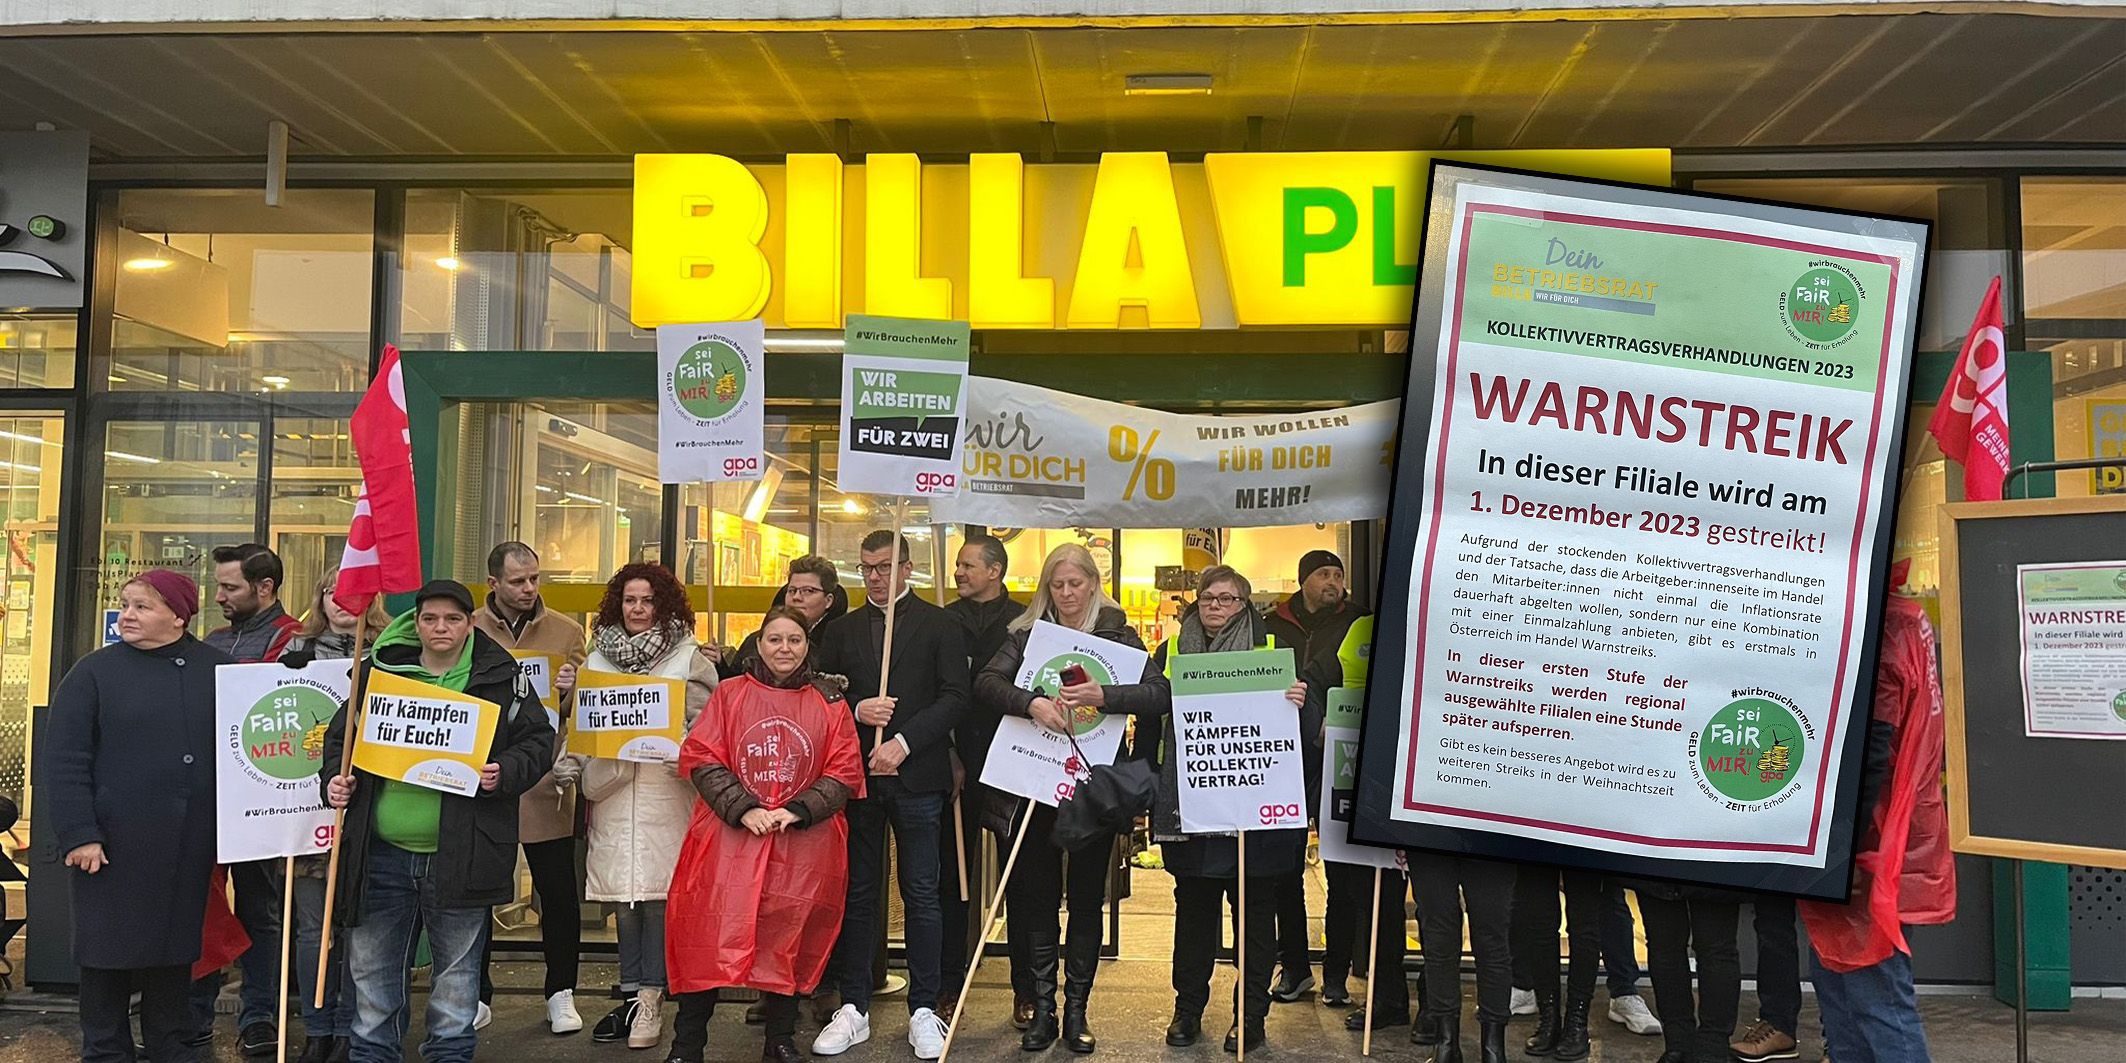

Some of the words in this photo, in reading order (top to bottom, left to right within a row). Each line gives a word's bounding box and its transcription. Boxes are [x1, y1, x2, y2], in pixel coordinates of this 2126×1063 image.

[631, 151, 1201, 329] BILLA
[1282, 186, 1418, 288] PL
[1546, 237, 1604, 270] Dein
[1492, 263, 1658, 300] BETRIEBSRAT
[1813, 276, 1830, 287] sei
[1536, 292, 1548, 301] WIR
[1549, 292, 1563, 303] FÜR
[1563, 295, 1580, 305] DICH
[856, 331, 959, 346] #WirBrauchenMehr
[1486, 319, 1811, 374] KOLLEKTIVVERTRAGSVERHANDLUNGEN
[1813, 360, 1855, 379] 2023
[695, 347, 712, 360] sei
[860, 371, 897, 388] WIR
[858, 390, 951, 411] ARBEITEN
[1196, 425, 1246, 440] WIR
[1253, 415, 1349, 436] WOLLEN
[1469, 371, 1854, 465] WARNSTREIK
[675, 439, 744, 448] #WirBrauchenMehr
[858, 426, 896, 446] FÜR
[900, 431, 949, 449] ZWEI
[1984, 423, 2010, 460] MEINE
[963, 443, 1002, 477] ÜR
[1009, 453, 1086, 483] DICH
[1108, 424, 1176, 502] %
[1217, 448, 1267, 473] FÜR
[1272, 445, 1332, 471] DICH
[1975, 432, 2010, 475] GEWERK
[723, 457, 757, 477] gpa
[915, 472, 955, 493] gpa
[1478, 448, 1505, 475] In
[1514, 452, 1607, 487] dieser
[1613, 465, 1699, 499] Filiale
[1708, 479, 1774, 508] wird
[1781, 493, 1828, 516] am
[1235, 484, 1311, 510] MEHR!
[1469, 490, 1492, 514] 1.
[1501, 493, 1633, 530] Dezember
[1639, 510, 1701, 538] 2023
[1706, 523, 1827, 555] gestreikt!
[1185, 533, 1202, 547] für
[124, 558, 183, 566] Restaurant
[1460, 533, 1518, 549] Aufgrund
[1528, 540, 1549, 552] der
[1557, 546, 1627, 562] stockenden
[1636, 553, 1825, 588] Kollektivvertragsverhandlungen
[1458, 552, 1482, 564] und
[1485, 554, 1507, 566] der
[1510, 556, 1566, 575] Tatsache,
[1570, 564, 1597, 577] dass
[1600, 567, 1619, 579] die
[1621, 570, 1759, 597] Arbeitgeber:innenseite
[1763, 587, 1778, 599] im
[1781, 590, 1824, 605] Handel
[1455, 569, 1478, 582] den
[1492, 573, 1600, 595] Mitarbeiter:innen
[1613, 588, 1644, 601] nicht
[1656, 593, 1697, 607] einmal
[1710, 599, 1728, 611] die
[1742, 603, 1822, 624] Inflationsrate
[1453, 587, 1514, 605] dauerhaft
[1520, 595, 1572, 611] abgelten
[1579, 603, 1622, 619] wollen,
[1629, 610, 1678, 623] sondern
[1684, 617, 1705, 626] nur
[1711, 618, 1737, 631] eine
[1743, 622, 1819, 642] Kombination
[2029, 610, 2126, 625] WARNSTRE
[1449, 621, 1513, 641] Österreich
[1516, 631, 1531, 643] im
[1535, 633, 1578, 648] Handel
[1582, 638, 1656, 658] Warnstreiks.
[1451, 606, 1472, 618] mit
[1482, 609, 1514, 622] einer
[1524, 613, 1612, 636] Einmalzahlung
[1621, 626, 1678, 643] anbieten,
[1688, 633, 1712, 646] gibt
[1722, 639, 1735, 649] es
[1745, 642, 1796, 657] erstmals
[1806, 647, 1817, 659] in
[2045, 631, 2072, 639] dieser
[2074, 630, 2100, 639] Filiale
[2102, 630, 2124, 639] wird
[2043, 642, 2083, 650] Dezember
[1182, 667, 1283, 680] #WirBrauchenMehr
[1448, 649, 1461, 662] In
[1479, 653, 1525, 670] dieser
[1542, 663, 1588, 678] ersten
[1606, 668, 1645, 685] Stufe
[1663, 675, 1688, 689] der
[273, 693, 298, 710] sei
[578, 690, 597, 707] Wir
[600, 687, 660, 708] kämpfen
[1446, 669, 1533, 693] Warnstreiks
[1551, 686, 1607, 702] werden
[1625, 695, 1685, 711] regional
[370, 695, 394, 716] Wir
[396, 699, 469, 725] kämpfen
[588, 711, 608, 729] für
[611, 709, 648, 728] Euch!
[1182, 711, 1213, 725] WIR
[1444, 693, 1536, 714] ausgewählte
[1540, 703, 1591, 721] Filialen
[1596, 711, 1627, 726] eine
[1630, 715, 1682, 732] Stunde
[1731, 686, 1816, 741] #wirbrauchenmehr
[1736, 706, 1760, 722] sei
[281, 731, 297, 740] zu
[377, 721, 401, 742] für
[404, 724, 451, 747] Euch!
[1041, 730, 1058, 742] ZEIT
[1184, 724, 1261, 741] KÄMPFEN
[1442, 712, 1489, 729] später
[1492, 718, 1574, 742] aufsperren.
[1185, 741, 1216, 757] FÜR
[1221, 739, 1295, 755] UNSEREN
[1688, 731, 1699, 758] GELD
[1739, 747, 1754, 756] zu
[229, 724, 239, 750] GELD
[275, 781, 297, 790] ZEIT
[1186, 757, 1279, 773] KOLLEKTIV-
[1440, 738, 1464, 750] Gibt
[1467, 744, 1480, 753] es
[1483, 743, 1507, 757] kein
[1510, 747, 1561, 764] besseres
[1564, 755, 1615, 772] Angebot
[1618, 764, 1644, 775] wird
[1647, 768, 1660, 777] es
[1663, 770, 1676, 779] zu
[1706, 756, 1752, 776] MIR!
[1187, 773, 1265, 789] VERTRAG!
[1437, 771, 1491, 788] kommen.
[1438, 756, 1490, 771] weiteren
[1496, 763, 1535, 778] Streiks
[1541, 769, 1551, 780] in
[1557, 771, 1577, 783] der
[1583, 775, 1675, 796] Weihnachtszeit
[1688, 759, 1700, 780] zum
[1759, 771, 1784, 783] gpa
[1696, 778, 1719, 803] Leben
[1763, 782, 1802, 810] Erholung
[1259, 803, 1299, 825] gpa
[1725, 800, 1747, 813] ZEIT
